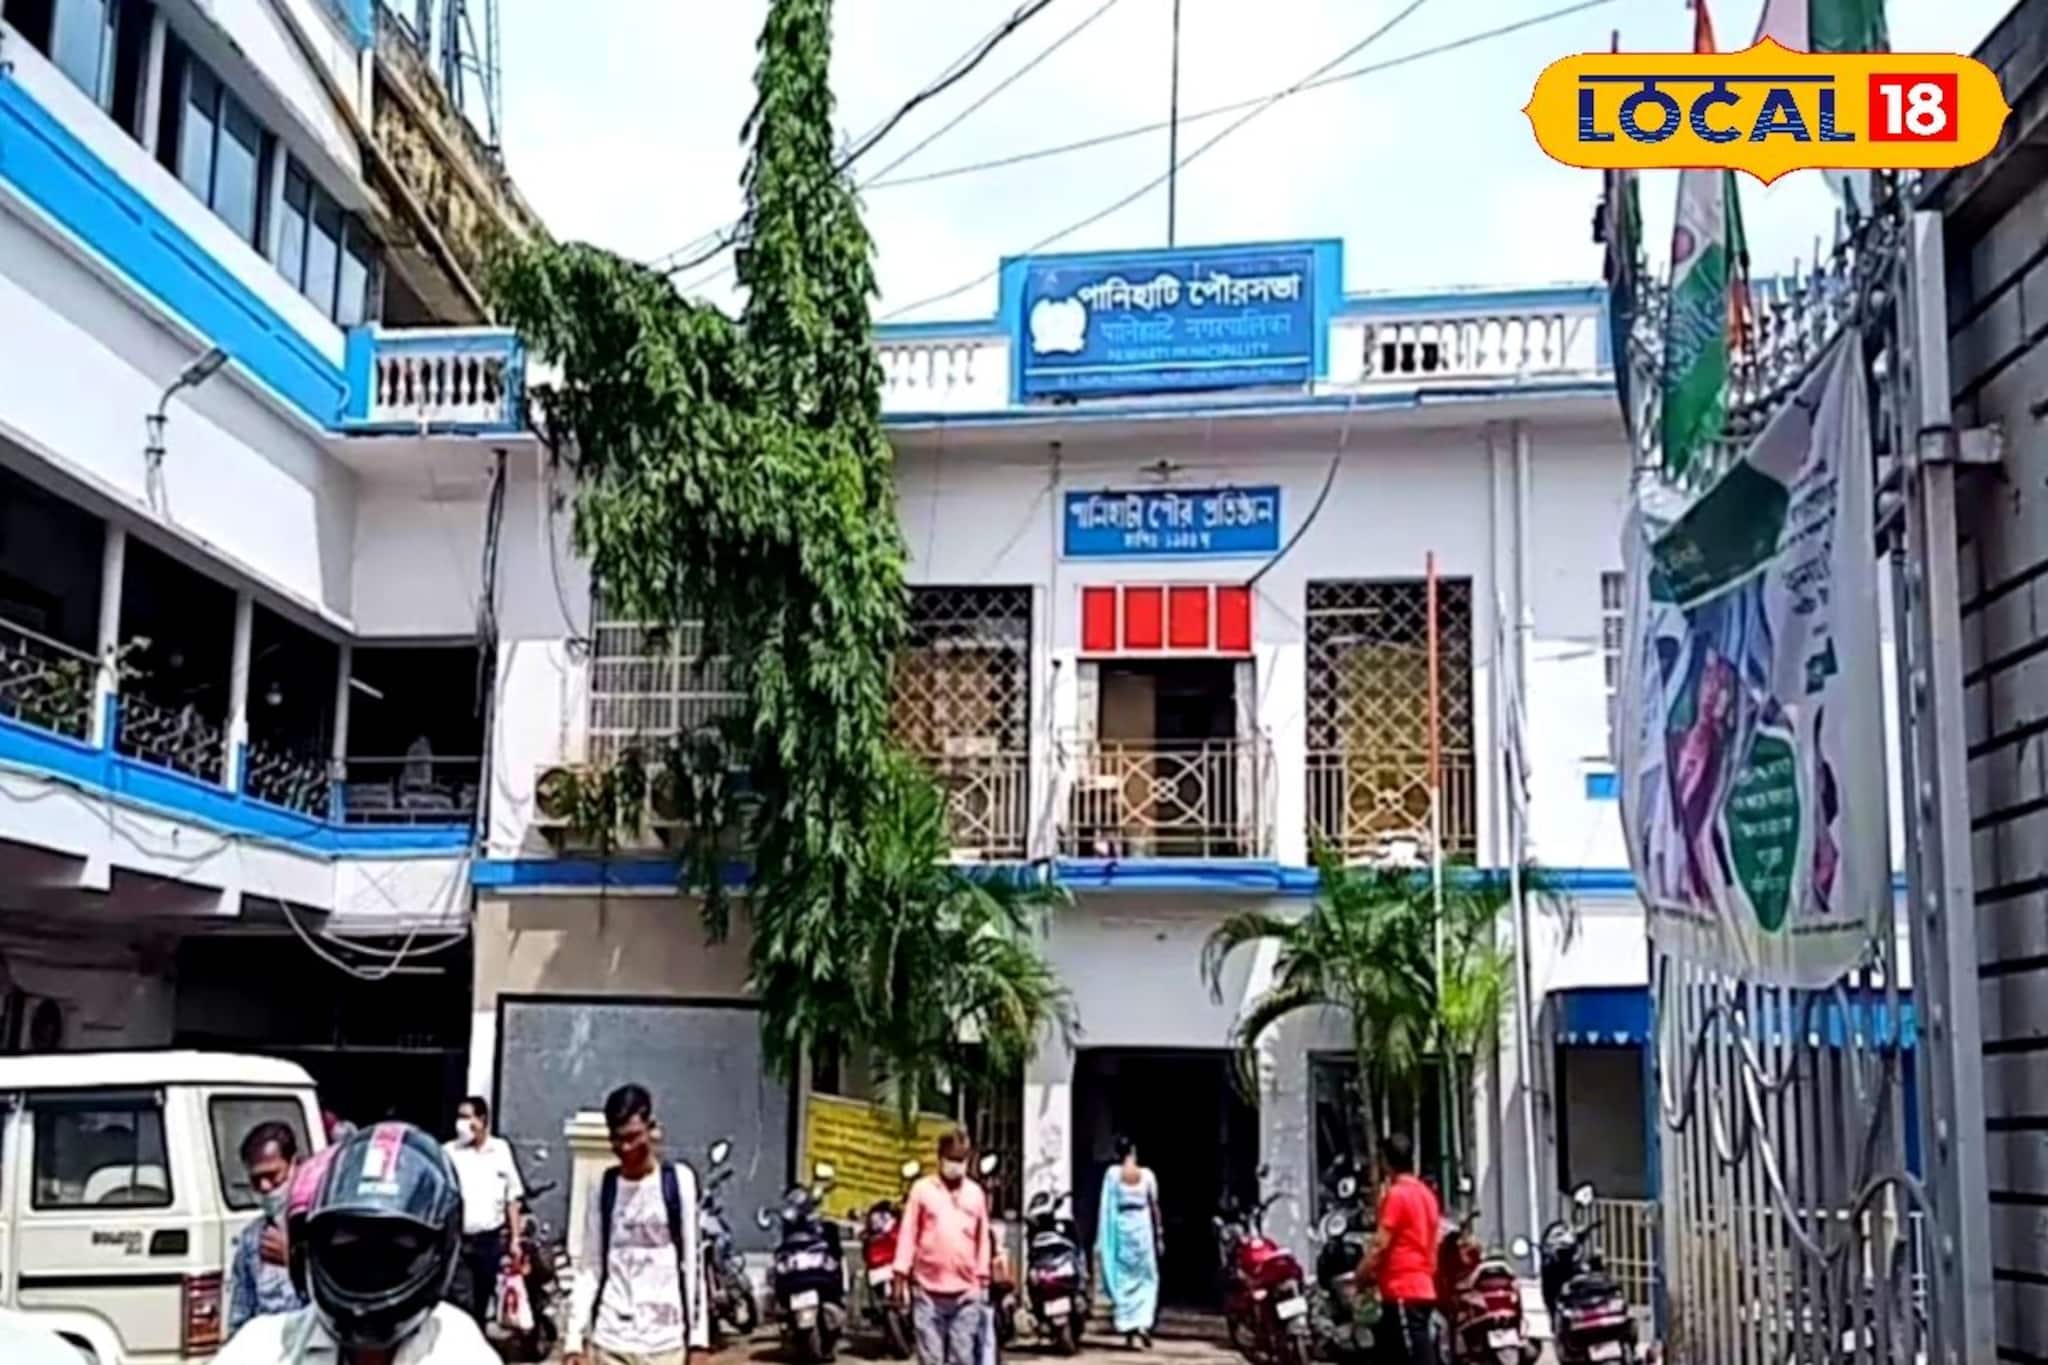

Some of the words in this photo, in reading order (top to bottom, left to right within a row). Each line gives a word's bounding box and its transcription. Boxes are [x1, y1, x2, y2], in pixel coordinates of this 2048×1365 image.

[1078, 275, 1180, 311] পানিহাটি
[1187, 272, 1301, 306] পৌরসভা
[1147, 493, 1193, 528] পৌর
